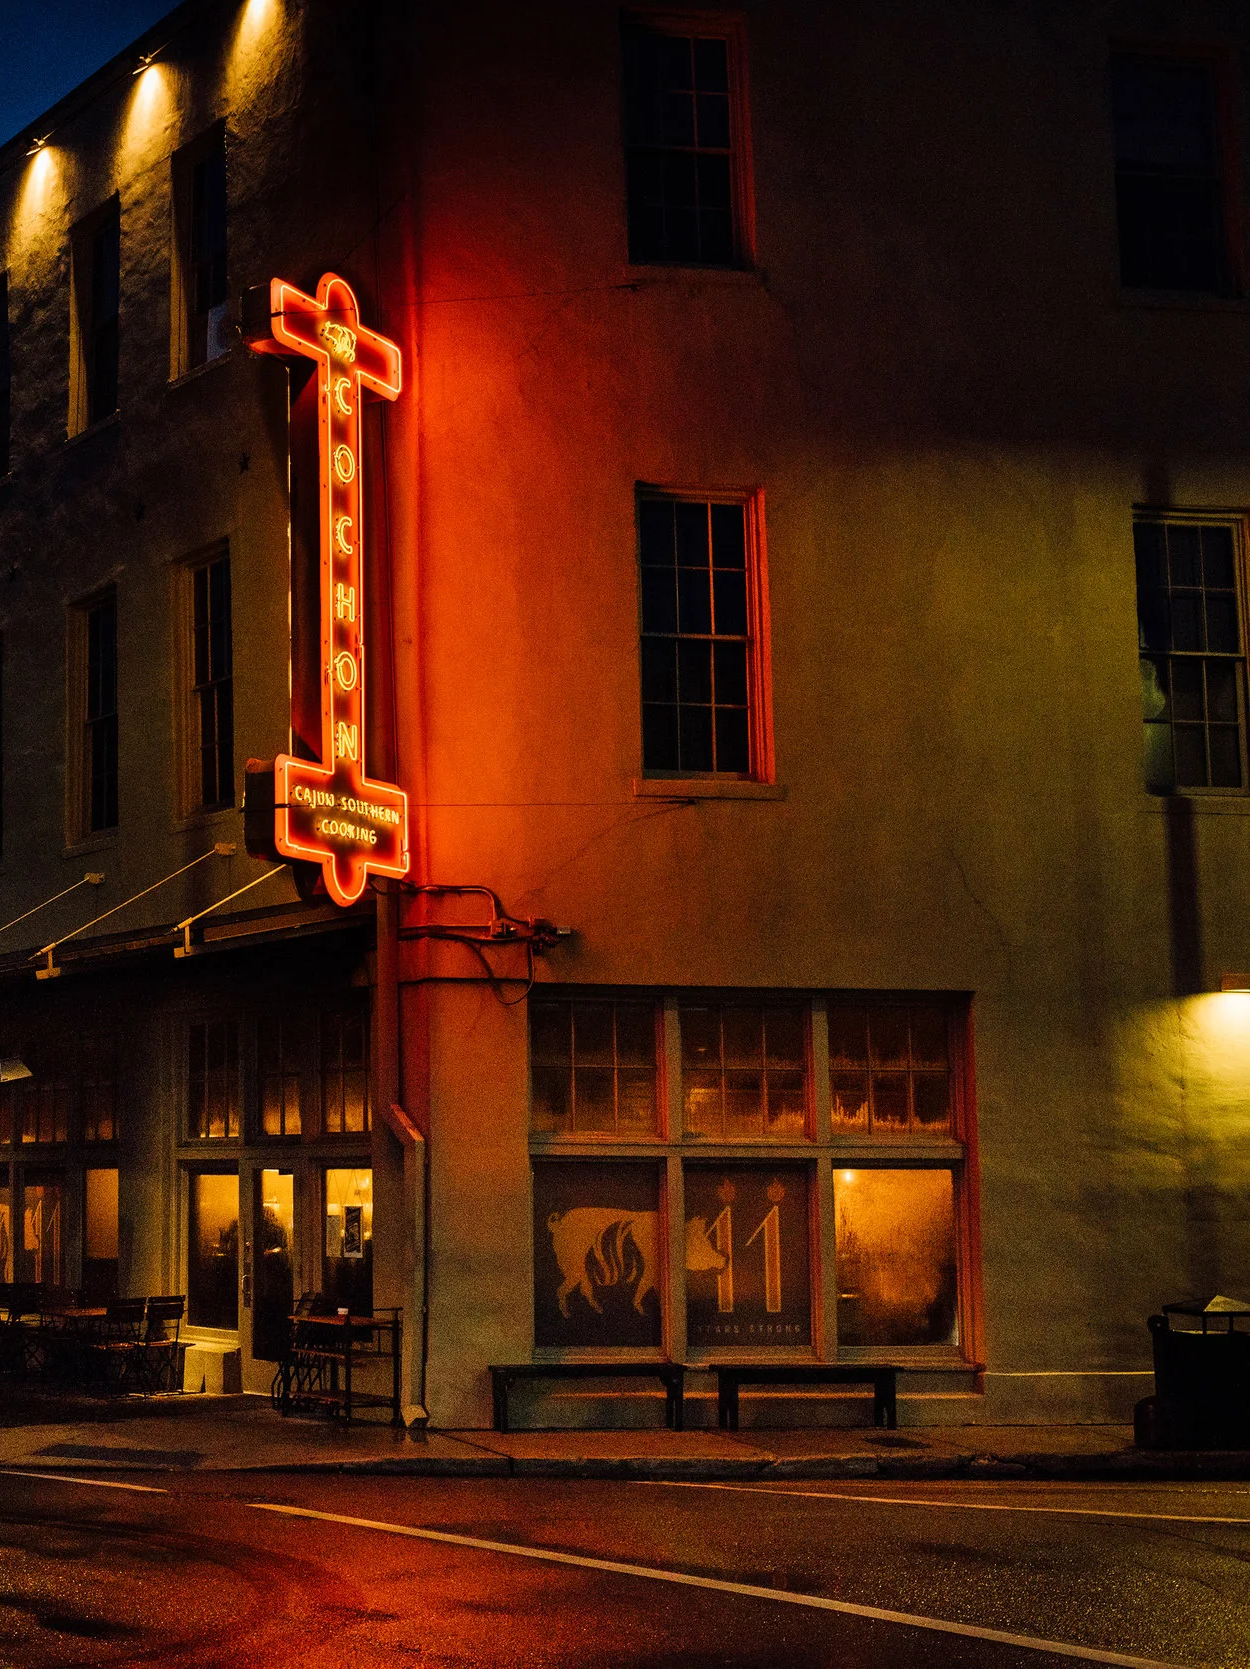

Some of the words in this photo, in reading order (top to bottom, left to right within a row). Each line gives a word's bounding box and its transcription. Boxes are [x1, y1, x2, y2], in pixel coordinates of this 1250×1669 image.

[335, 377, 358, 761] COCHON
[294, 785, 335, 809] CAJUN
[341, 796, 400, 825] SOUTHERN
[321, 818, 378, 845] COOKING
[706, 1204, 782, 1314] 11
